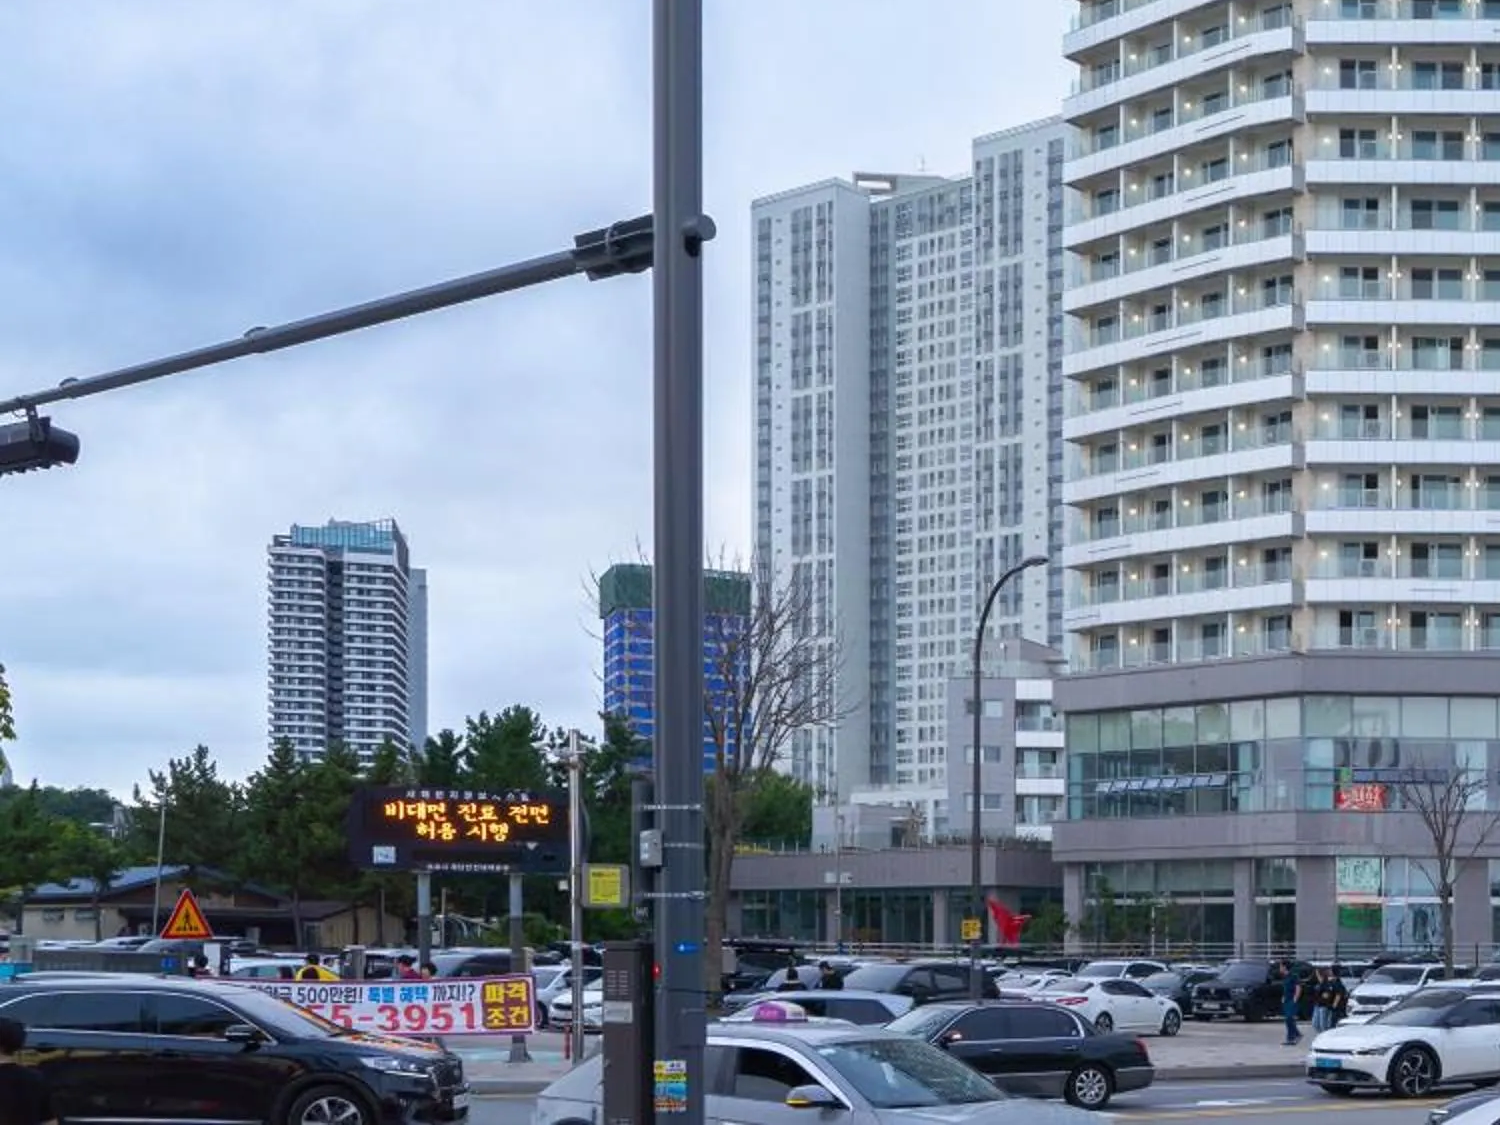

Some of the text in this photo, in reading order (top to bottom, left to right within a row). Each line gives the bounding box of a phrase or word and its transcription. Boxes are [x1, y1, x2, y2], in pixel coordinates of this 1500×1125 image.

[384, 800, 550, 824] 비대면 진료 전면
[415, 821, 509, 842] 허용 시행
[484, 981, 527, 1004] 파격
[306, 1002, 476, 1032] 5-3951
[486, 1005, 529, 1027] 조건
